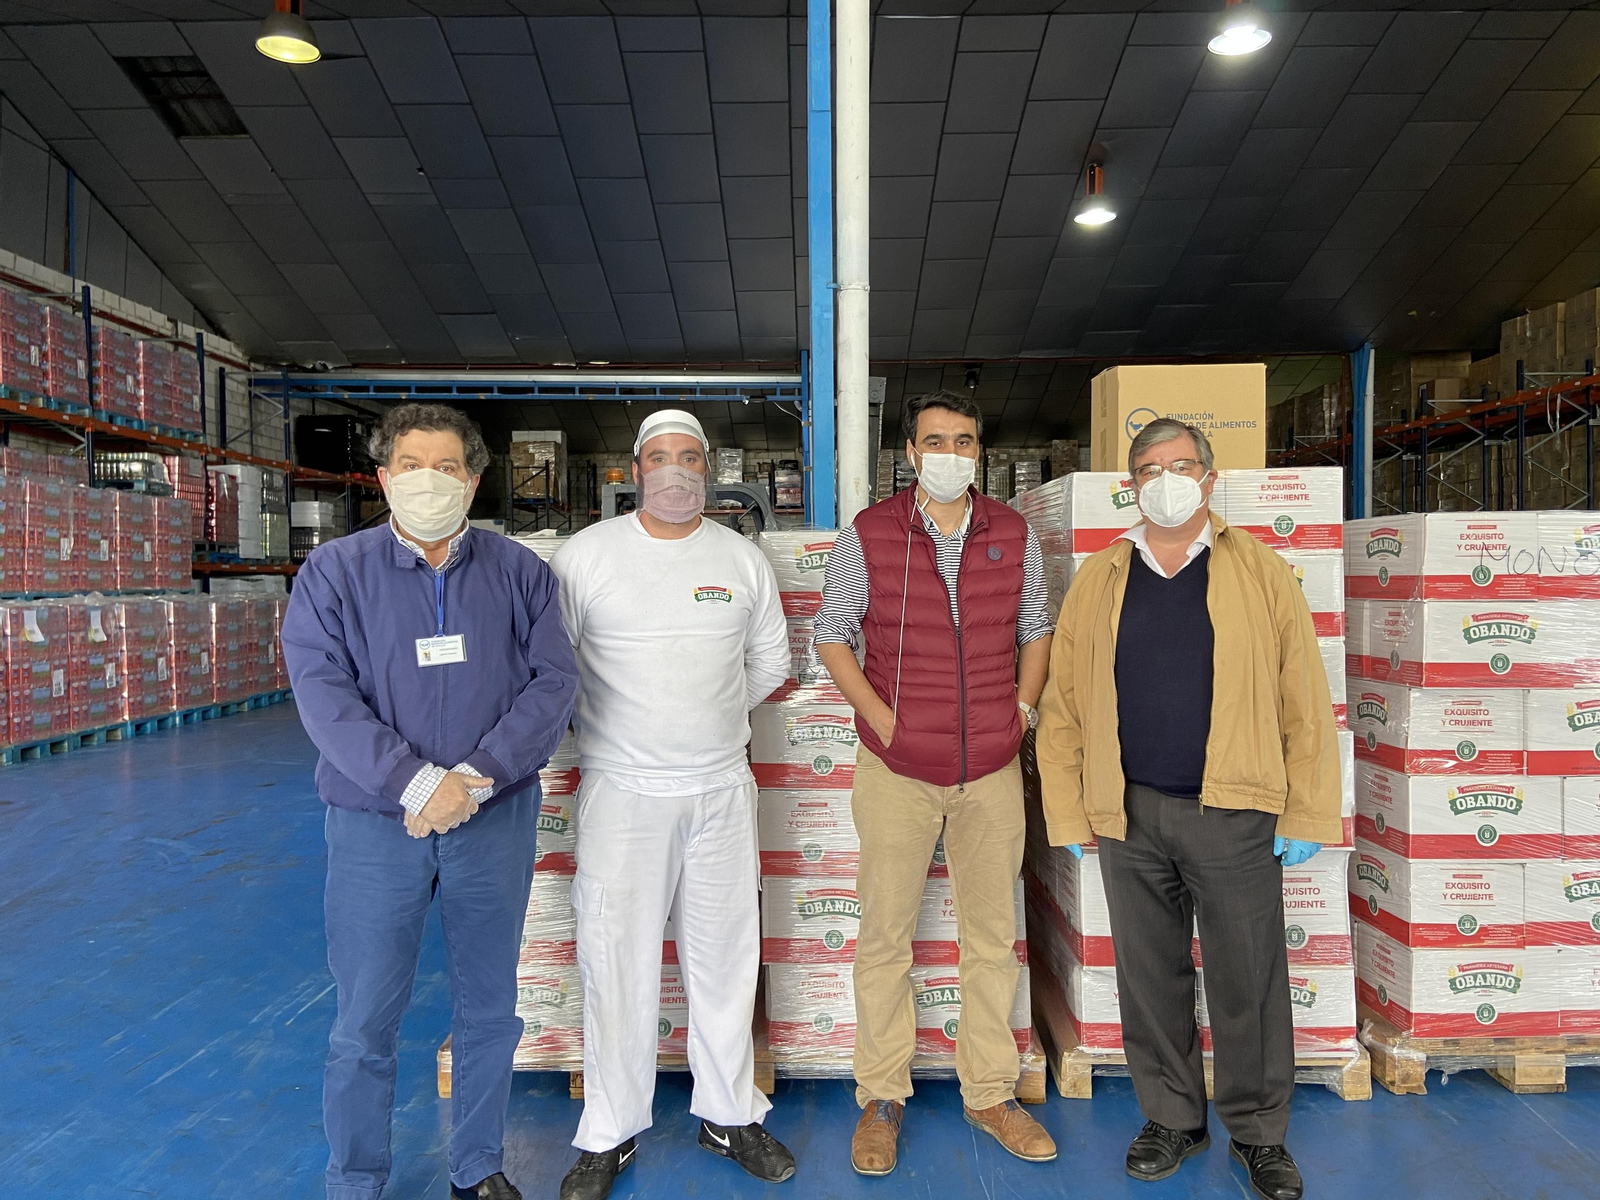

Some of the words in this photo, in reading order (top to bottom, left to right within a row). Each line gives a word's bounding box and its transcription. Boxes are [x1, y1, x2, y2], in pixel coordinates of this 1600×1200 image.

[1166, 410, 1214, 421] FUNDACIÓN
[1209, 420, 1257, 429] ALIMENTOS
[1260, 483, 1307, 491] EXQUISITO
[1459, 533, 1505, 541] EXQUISITO
[1368, 538, 1400, 554] OBANDO
[1456, 543, 1463, 551] Y
[1464, 543, 1507, 551] CRUJIENTE
[697, 592, 730, 601] OBANDO
[1469, 623, 1531, 640] OBANDO
[1359, 703, 1386, 721] OBANDO
[1444, 708, 1490, 717] EXQUISITO
[1441, 719, 1447, 727] Y
[1448, 719, 1493, 727] CRUJIENTE
[1456, 794, 1517, 810] OBANDO
[787, 820, 793, 828] Y
[1359, 865, 1386, 888] OBANDO
[1445, 882, 1491, 890] EXQUISITO
[1283, 900, 1326, 909] UJIENTE
[1450, 893, 1494, 901] CRUJIENTE
[805, 900, 862, 916] OBANDO
[1455, 973, 1516, 990] OBANDO
